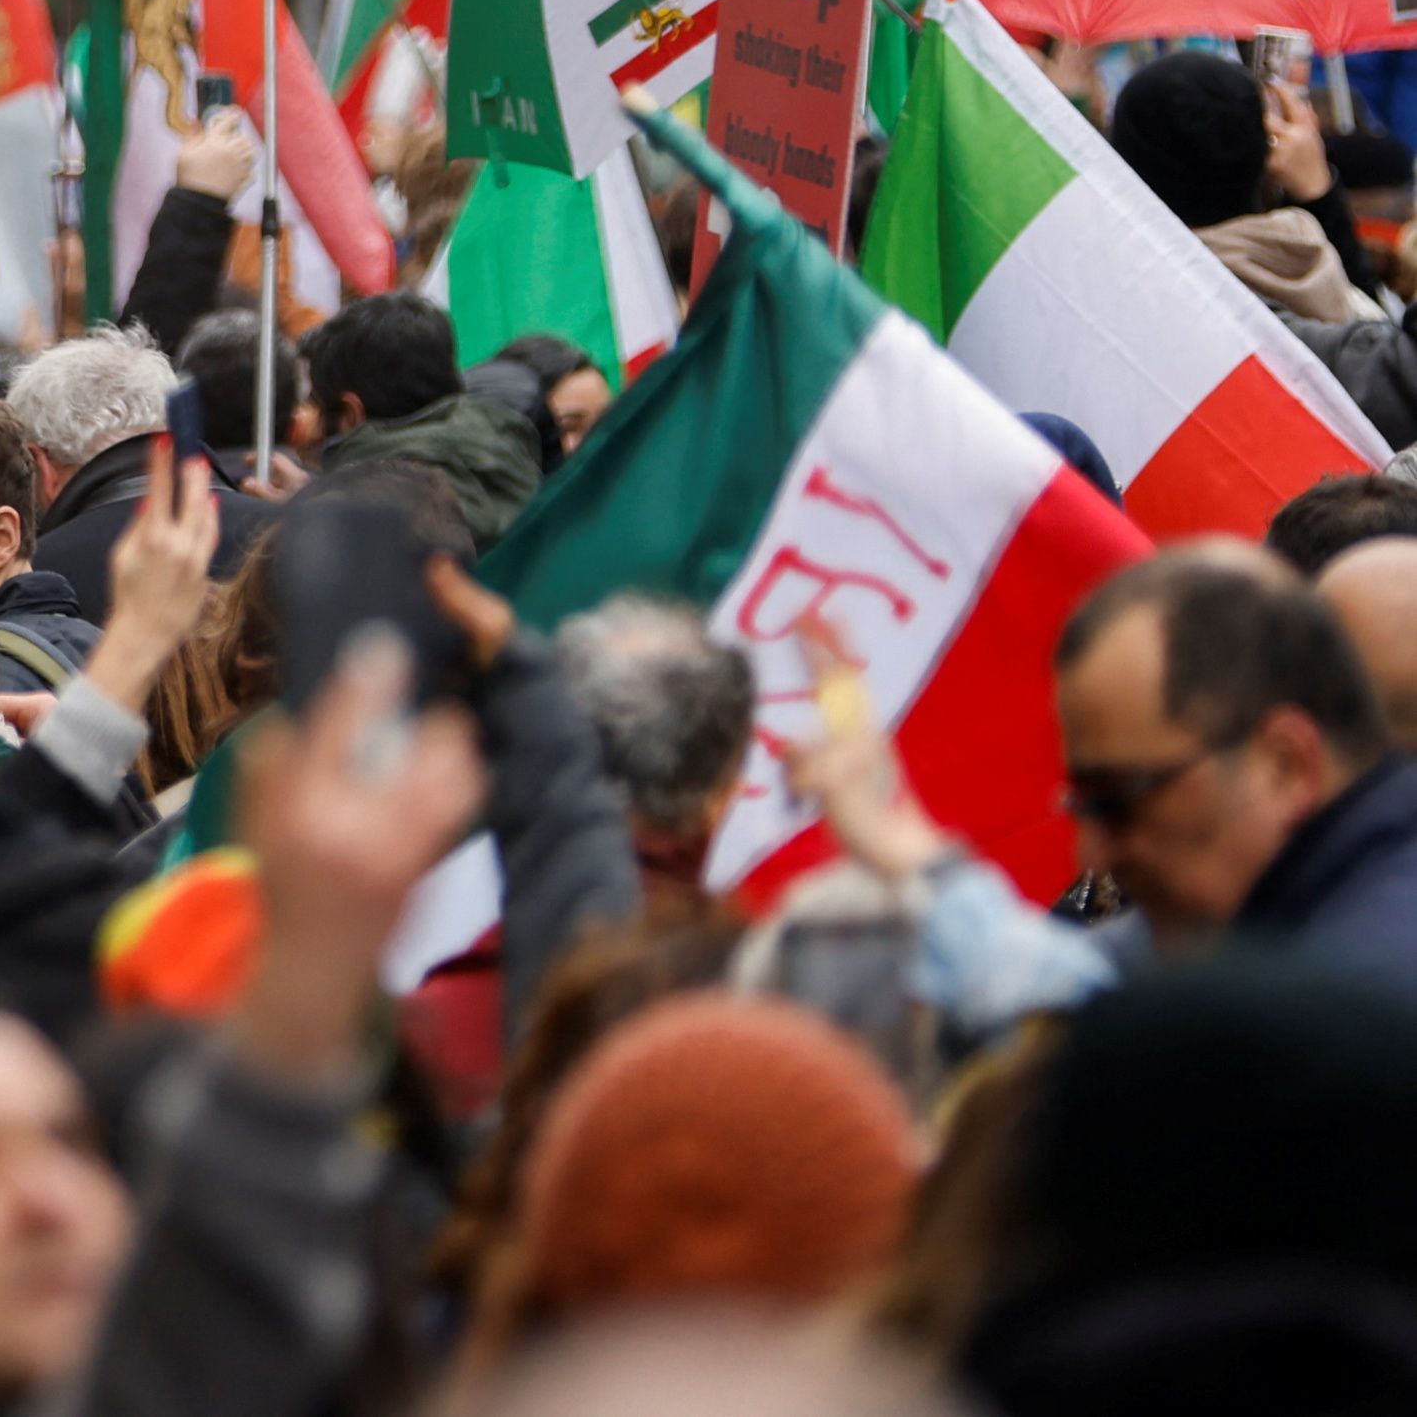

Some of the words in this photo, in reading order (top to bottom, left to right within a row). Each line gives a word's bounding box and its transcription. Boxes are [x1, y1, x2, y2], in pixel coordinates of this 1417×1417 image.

[733, 23, 802, 88] shaking
[805, 43, 847, 95] their
[469, 88, 539, 136] IAN
[724, 113, 780, 178] bloody
[781, 133, 837, 190] hands
